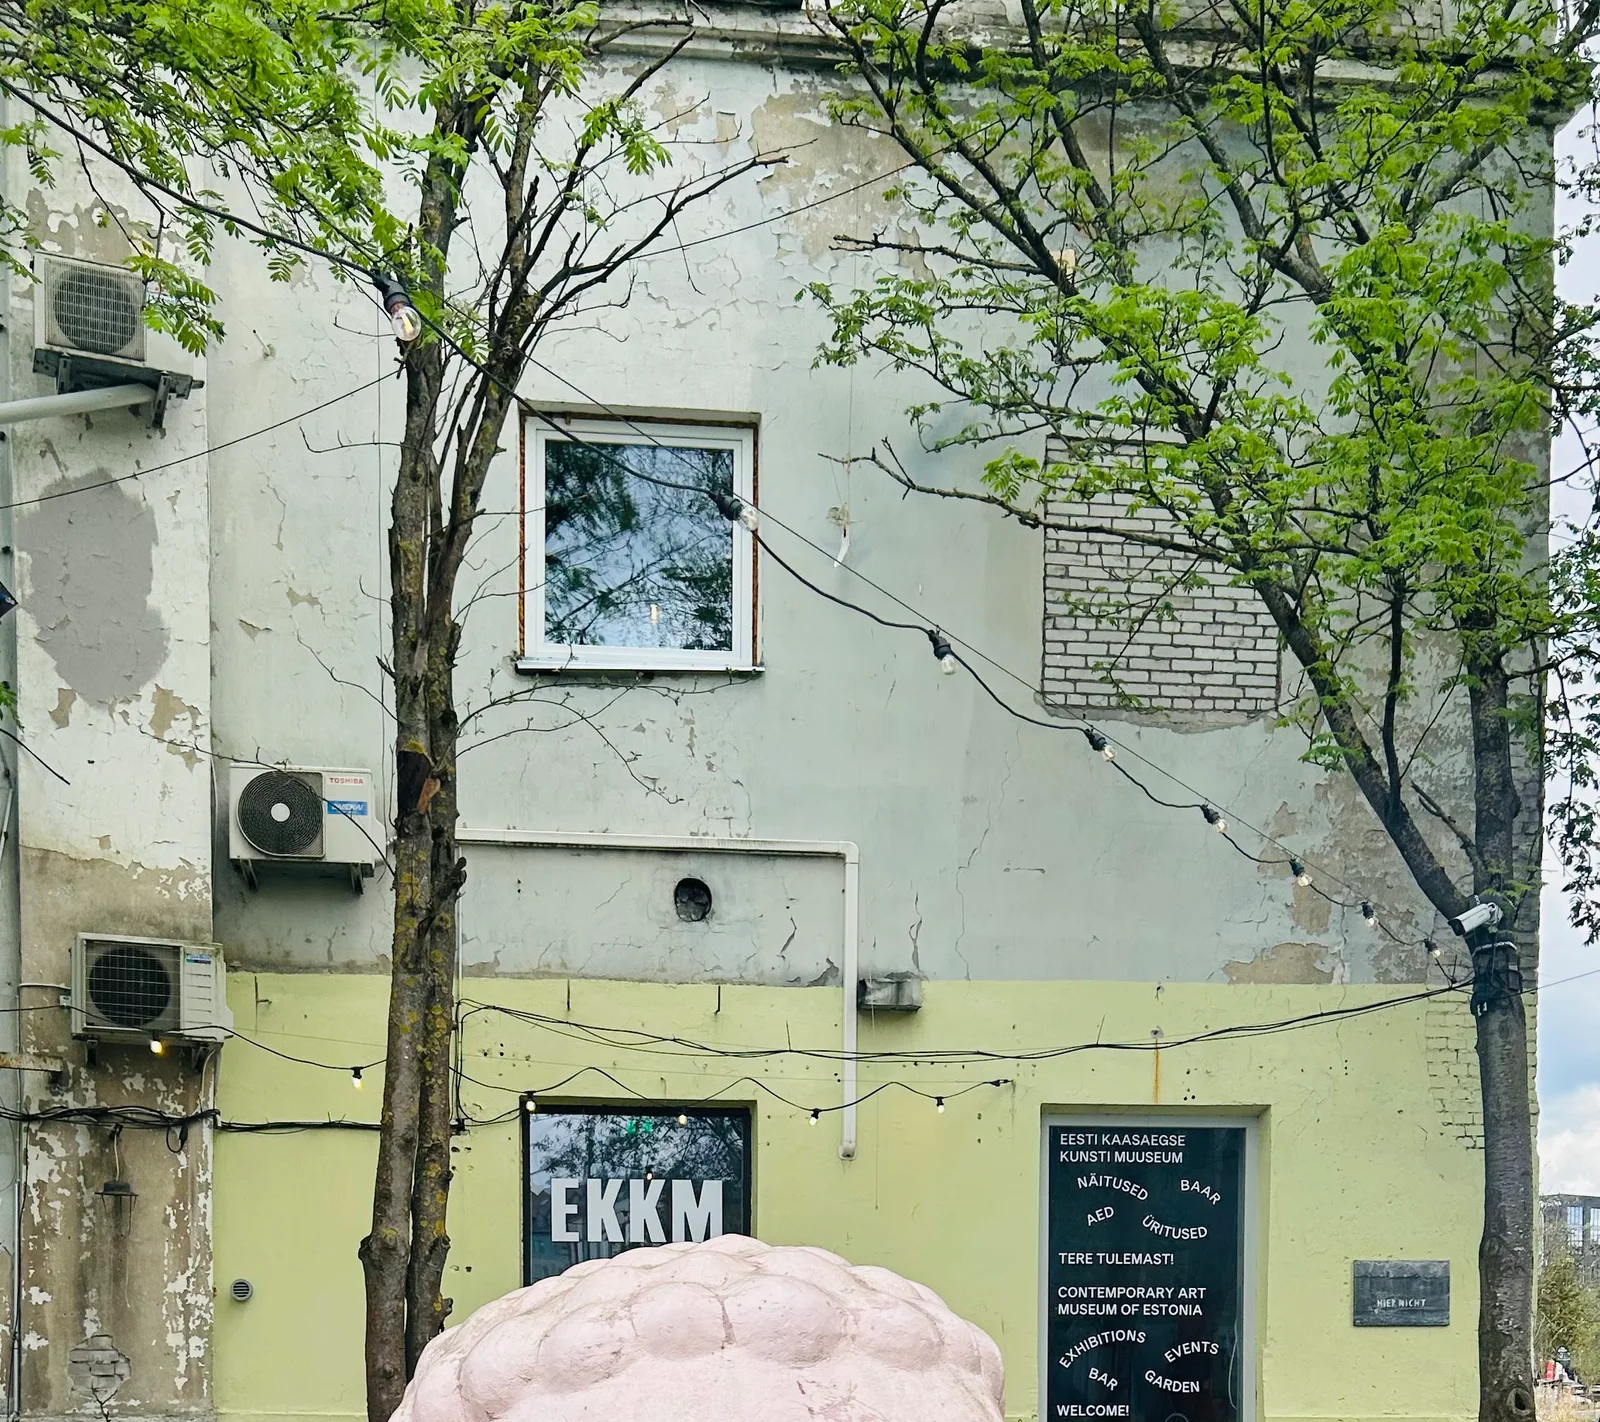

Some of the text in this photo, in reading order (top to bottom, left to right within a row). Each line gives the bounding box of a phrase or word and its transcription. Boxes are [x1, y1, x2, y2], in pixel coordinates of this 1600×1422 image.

[1060, 1134, 1186, 1147] EESTI KAASAEGSE
[1059, 1151, 1183, 1164] KUNSTI MUUSEUM
[1077, 1172, 1149, 1201] NÄITUSED
[1180, 1179, 1221, 1205] BAAR
[551, 1178, 723, 1243] EKKM
[1086, 1206, 1115, 1226] AED
[1142, 1214, 1208, 1240] ÜRITUSED
[1059, 1253, 1174, 1265] TERE TULEMAST!
[1058, 1286, 1207, 1299] CONTEMPORARY ART
[1398, 1298, 1426, 1308] NICHT
[1058, 1304, 1203, 1316] MUSEUM OF ESTONIA
[1059, 1329, 1147, 1369] EXHIBITIONS
[1164, 1341, 1219, 1363] EVENTS
[1088, 1367, 1118, 1391] BAR
[1144, 1369, 1200, 1393] GARDEN
[1057, 1405, 1130, 1417] WELCOME!
